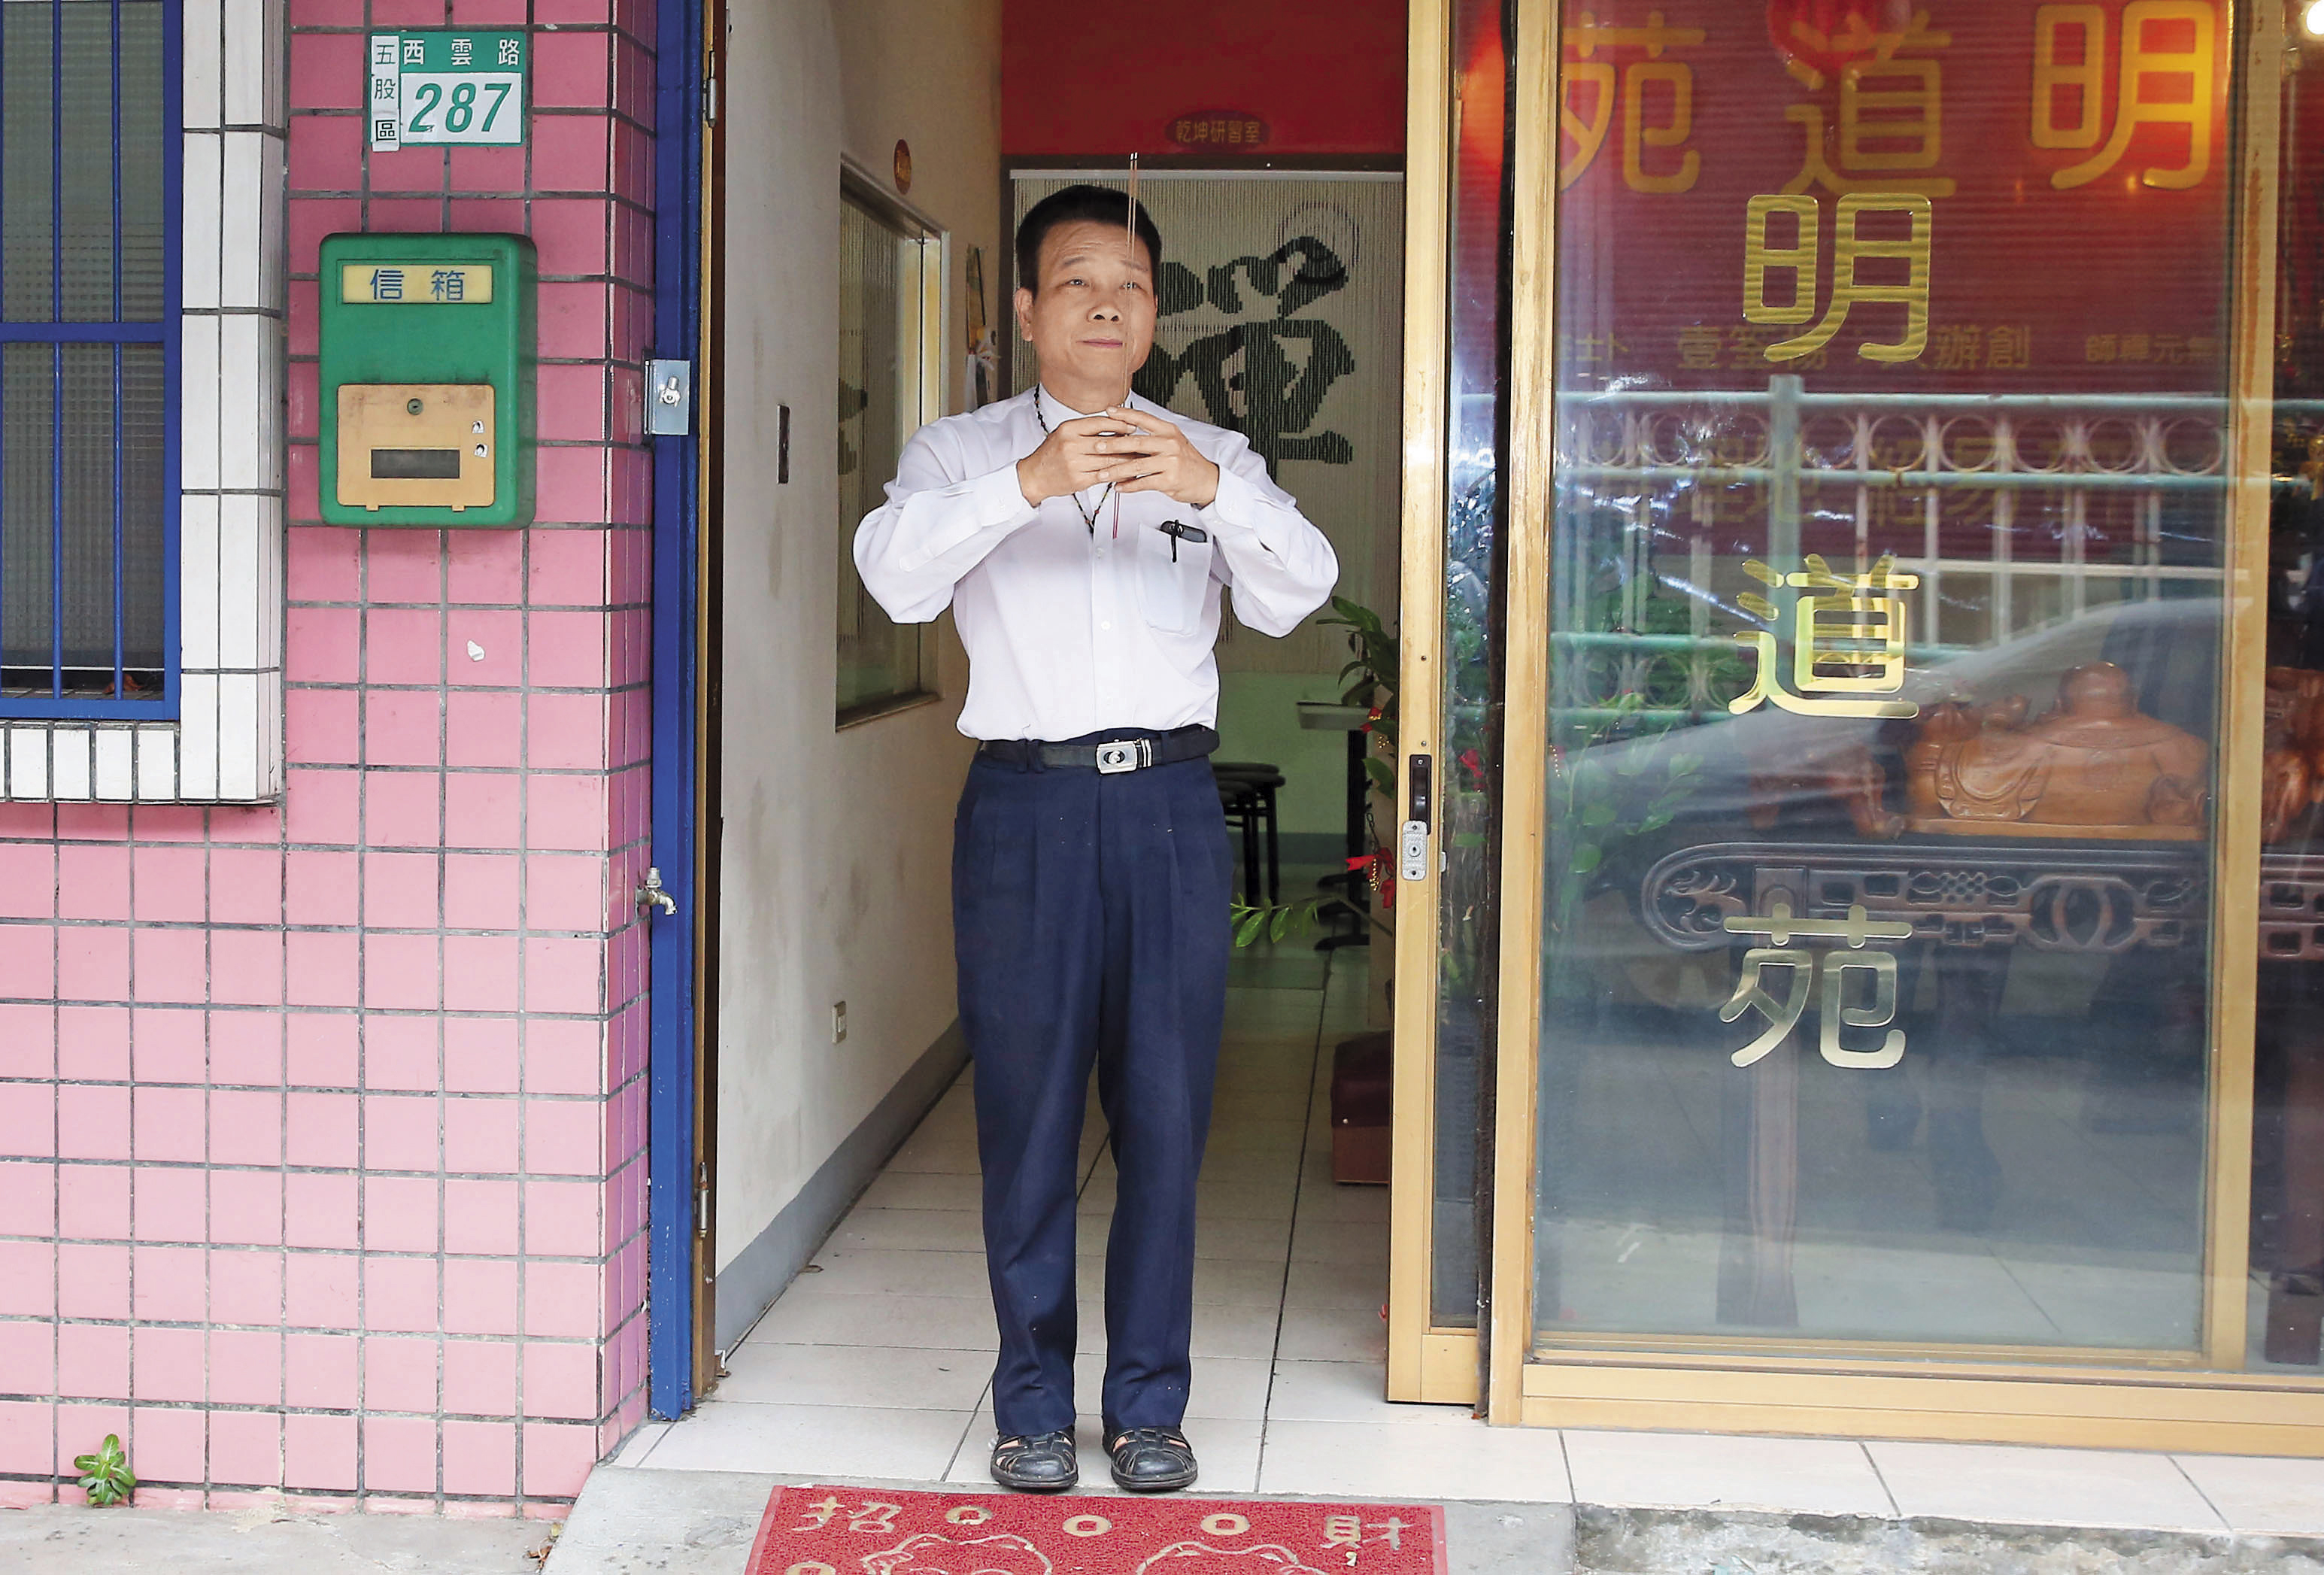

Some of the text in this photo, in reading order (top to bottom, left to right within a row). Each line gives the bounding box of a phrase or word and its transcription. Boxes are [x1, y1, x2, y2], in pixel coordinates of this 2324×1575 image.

[403, 38, 520, 67] 西雲路
[374, 44, 397, 142] 五股區
[408, 82, 512, 133] 287
[1561, 0, 2216, 199] 明道苑
[1176, 120, 1260, 144] 乾坤研習室
[369, 269, 466, 302] 信箱
[1719, 193, 1934, 1070] 明道苑
[791, 1496, 1416, 1551] 招 財
